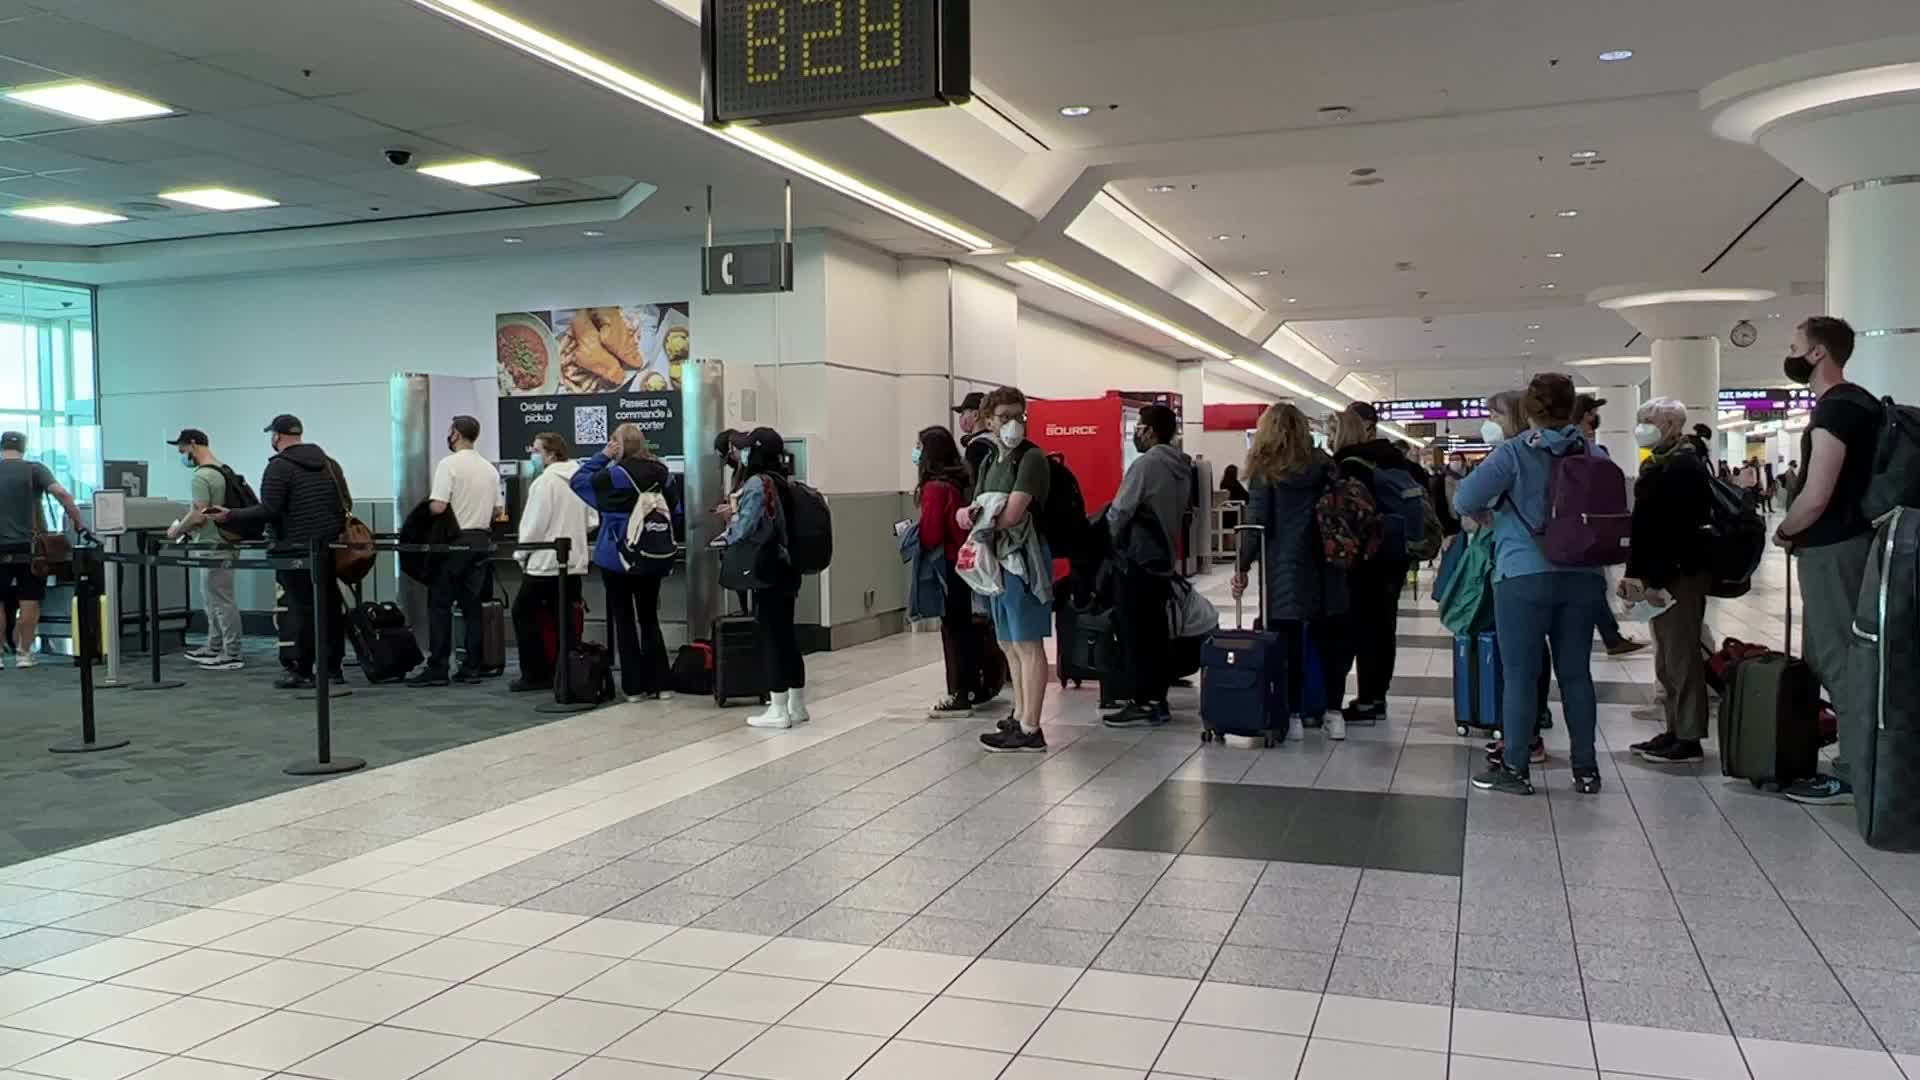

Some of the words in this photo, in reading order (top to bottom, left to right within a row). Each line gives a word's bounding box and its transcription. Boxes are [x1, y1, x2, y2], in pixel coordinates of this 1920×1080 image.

[520, 402, 544, 412] Order
[545, 401, 558, 411] for
[619, 398, 649, 408] Passez
[650, 399, 667, 408] une
[525, 413, 553, 424] pickup
[615, 409, 666, 420] commande
[667, 408, 673, 418] à
[1046, 426, 1097, 436] SOURCE
